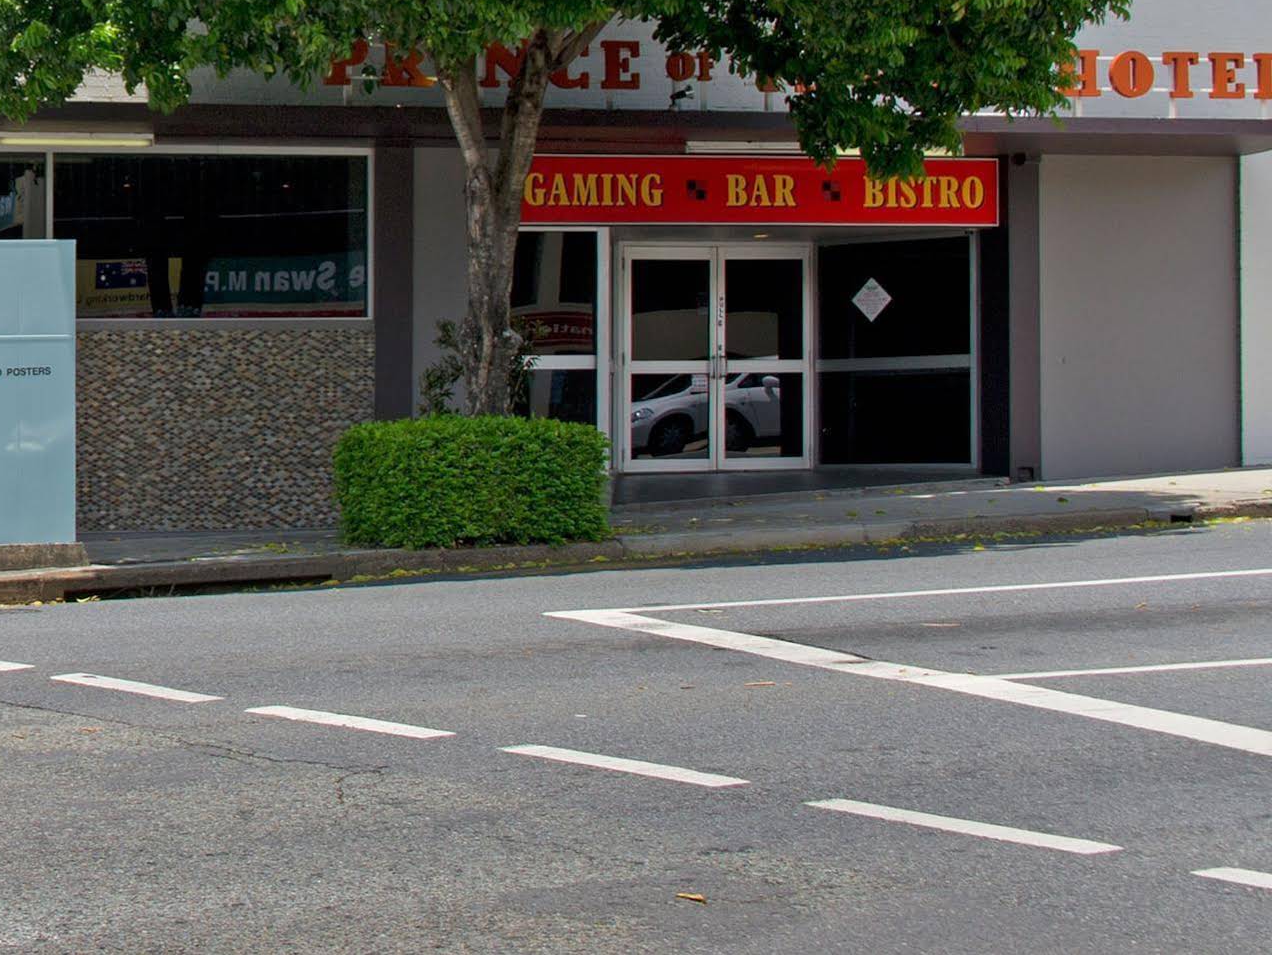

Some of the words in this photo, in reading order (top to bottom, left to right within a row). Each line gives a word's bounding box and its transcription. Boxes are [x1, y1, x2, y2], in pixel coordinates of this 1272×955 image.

[322, 36, 640, 90] PRNCE
[524, 172, 664, 207] GAMING
[725, 174, 797, 207] BAR
[863, 175, 985, 209] BISTRO
[6, 366, 52, 377] POSTERS
